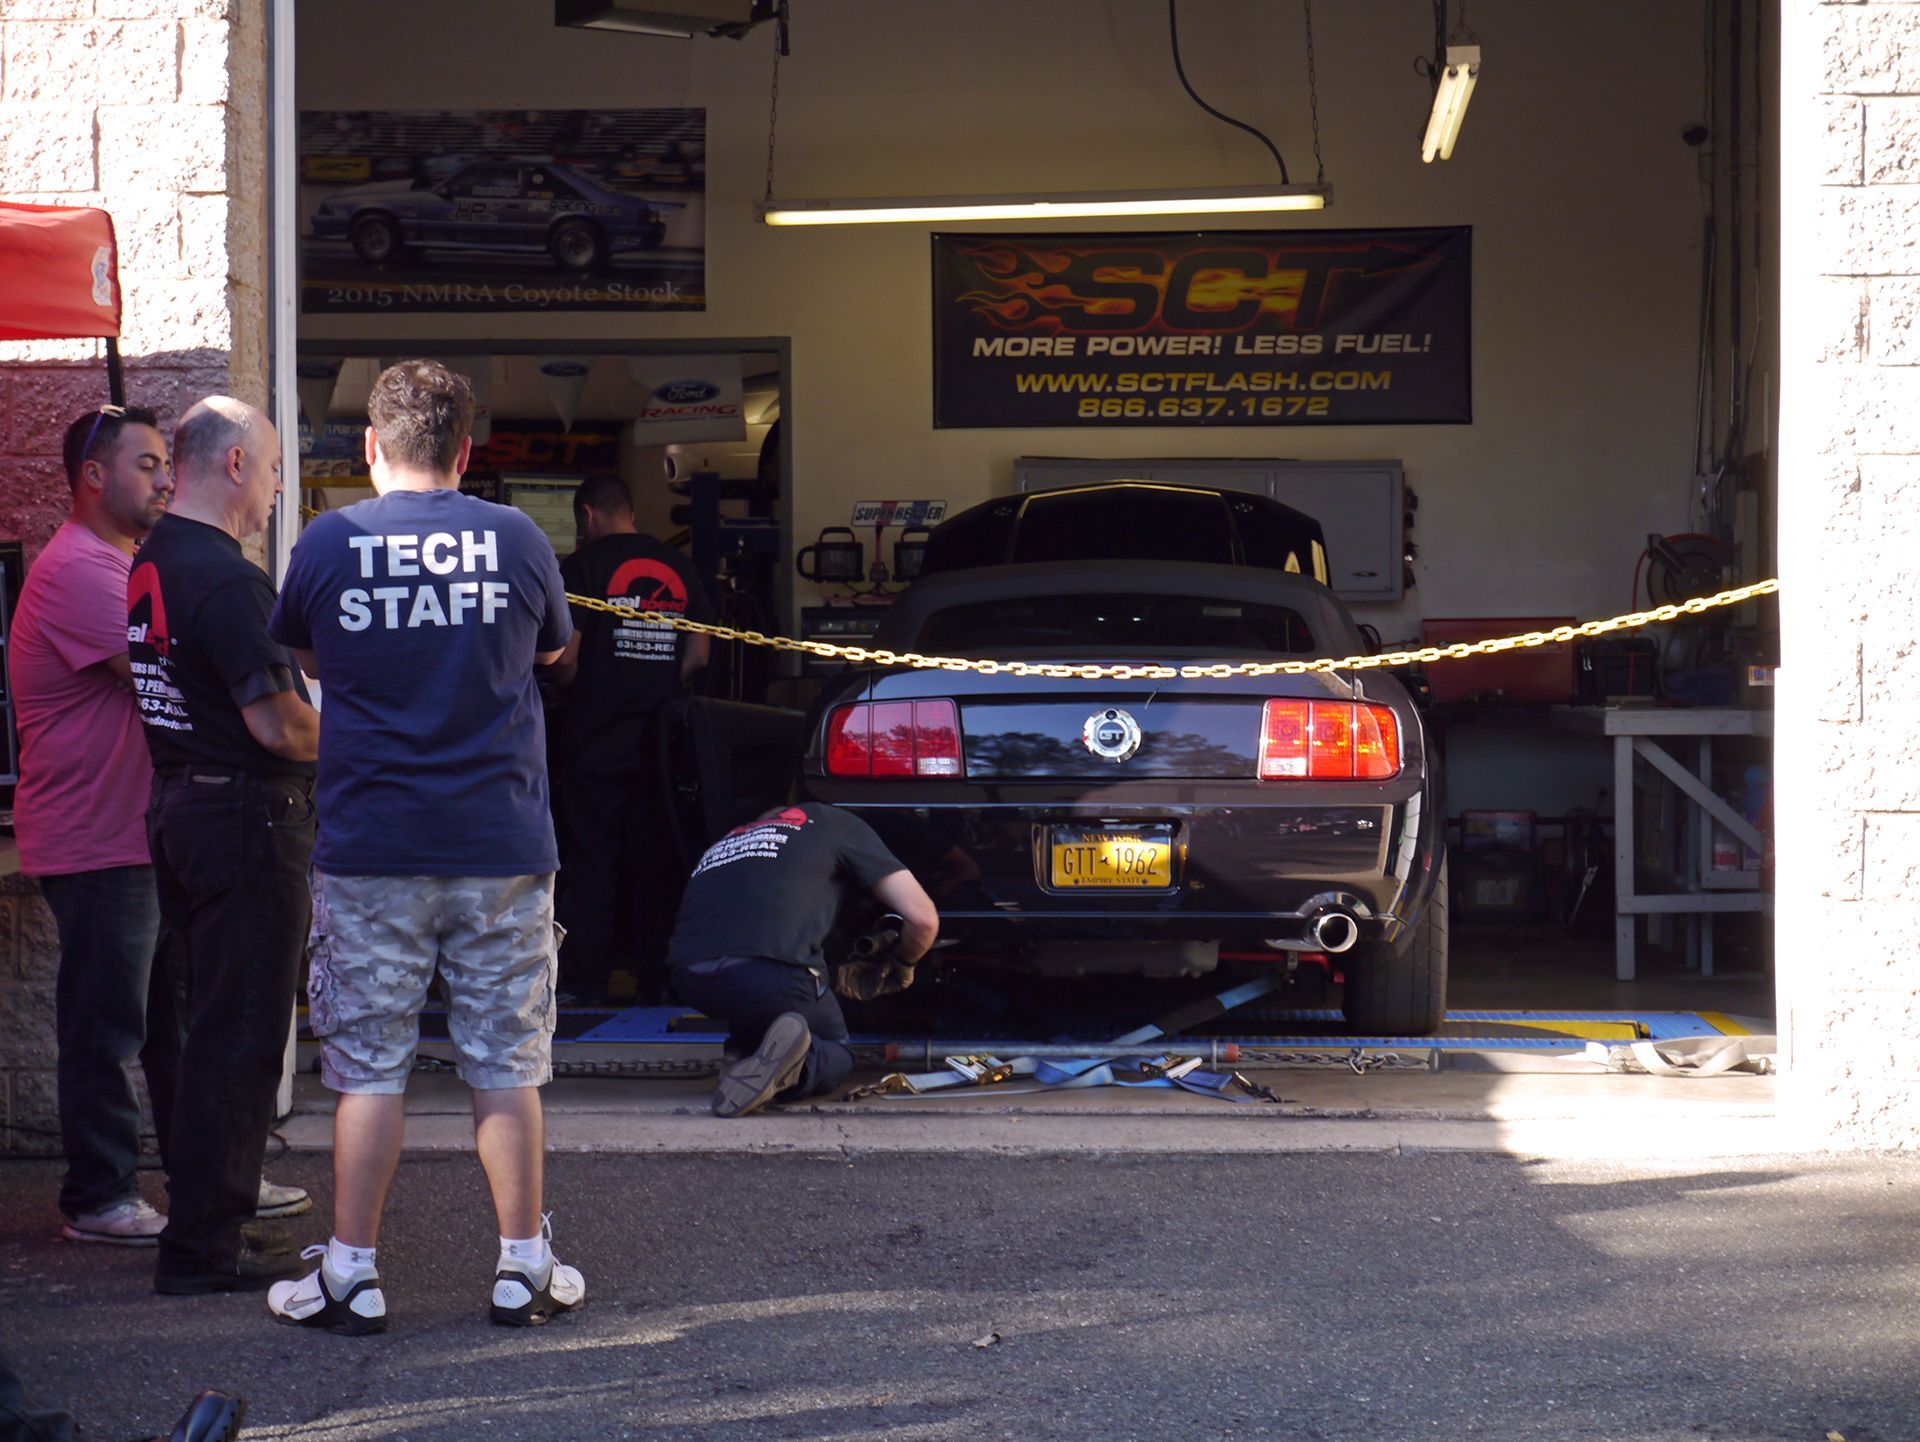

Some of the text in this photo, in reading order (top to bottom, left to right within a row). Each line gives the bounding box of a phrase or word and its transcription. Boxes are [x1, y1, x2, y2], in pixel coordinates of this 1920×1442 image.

[328, 281, 682, 307] 2015 NMRA Coyote Stock
[1058, 247, 1420, 333] SCT
[972, 333, 1432, 357] MORE POWER! LESS FUEL!
[666, 384, 707, 401] Ford
[1015, 370, 1392, 393] WWW.SCTFLASH.COM
[640, 404, 738, 419] RACING
[1077, 396, 1330, 418] 866.637.1672
[348, 530, 499, 578] TECH
[339, 582, 510, 631] STAFF
[1082, 832, 1108, 843] NEW
[1063, 847, 1158, 876] GTT 1962
[1081, 877, 1140, 886] EMPIRE STATE
